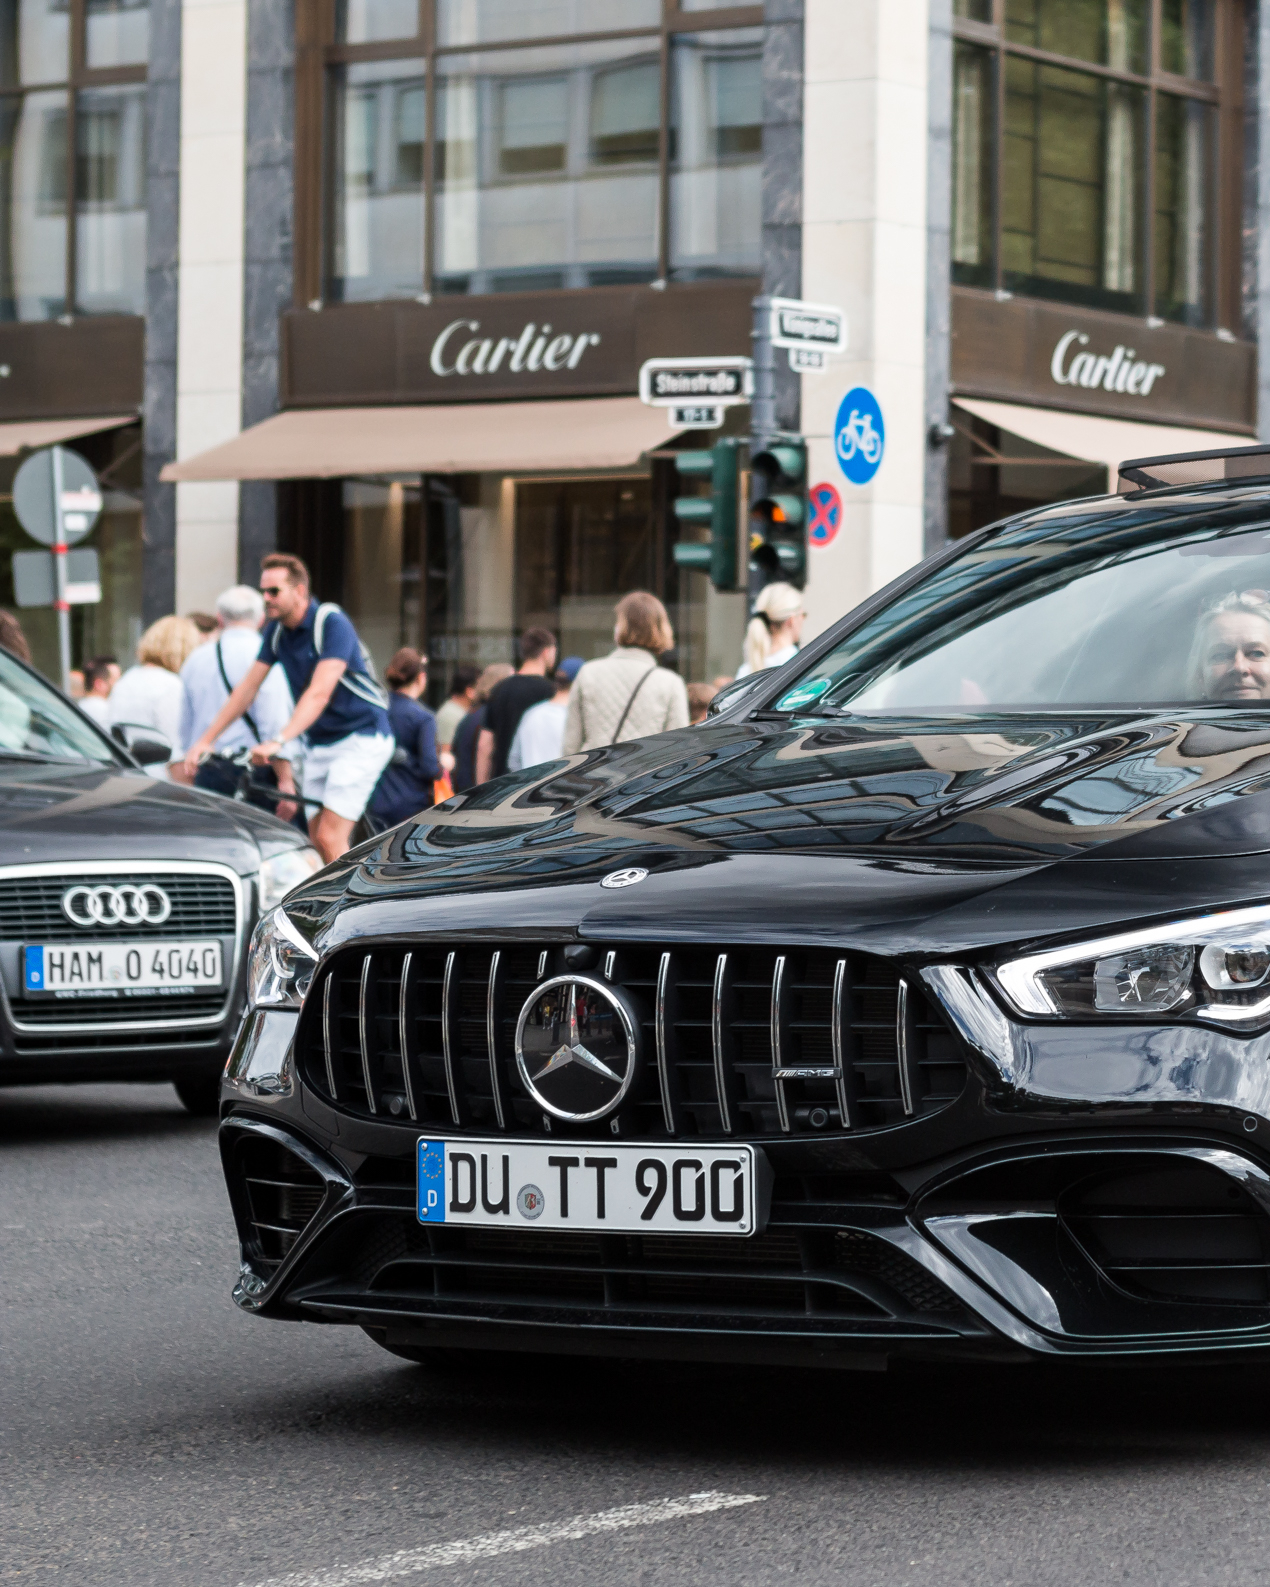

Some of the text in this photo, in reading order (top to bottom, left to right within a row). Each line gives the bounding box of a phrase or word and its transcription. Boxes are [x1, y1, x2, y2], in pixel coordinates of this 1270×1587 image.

[430, 318, 600, 377] Cartier
[1051, 329, 1165, 396] Cartier
[50, 950, 103, 983] HAM
[151, 948, 215, 980] 4040
[427, 1190, 438, 1207] D
[449, 1151, 510, 1215] DU
[548, 1156, 617, 1219] TT
[635, 1157, 744, 1222] 900
